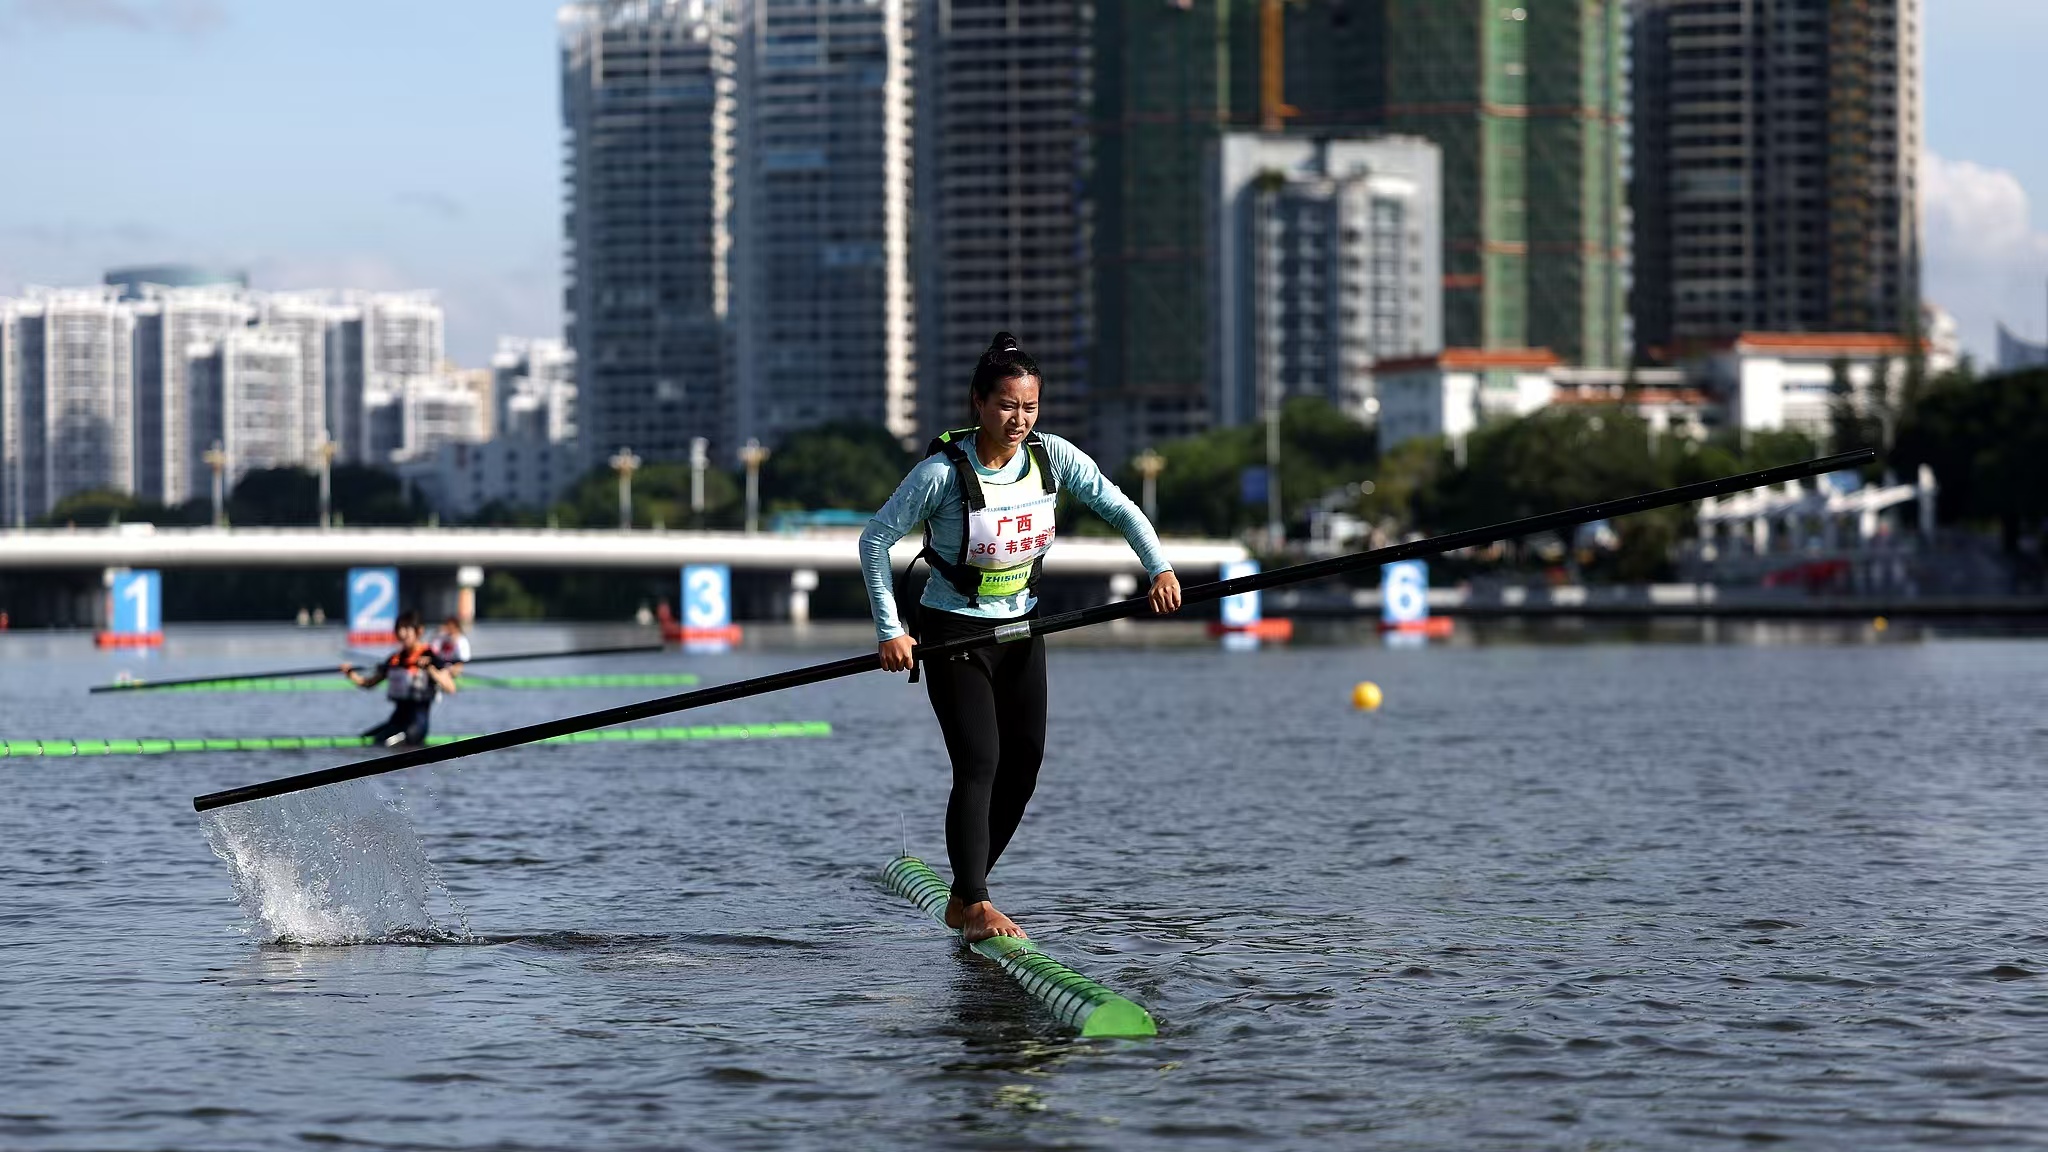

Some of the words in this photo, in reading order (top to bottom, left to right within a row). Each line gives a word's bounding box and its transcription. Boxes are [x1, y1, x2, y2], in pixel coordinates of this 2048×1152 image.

[996, 513, 1033, 537] 广西
[1004, 533, 1048, 555] 韦莹莹
[125, 574, 149, 632] 1
[352, 571, 396, 629] 2
[687, 568, 726, 628] 3
[985, 571, 1028, 583] ZHISHUI
[1386, 562, 1425, 623] 6
